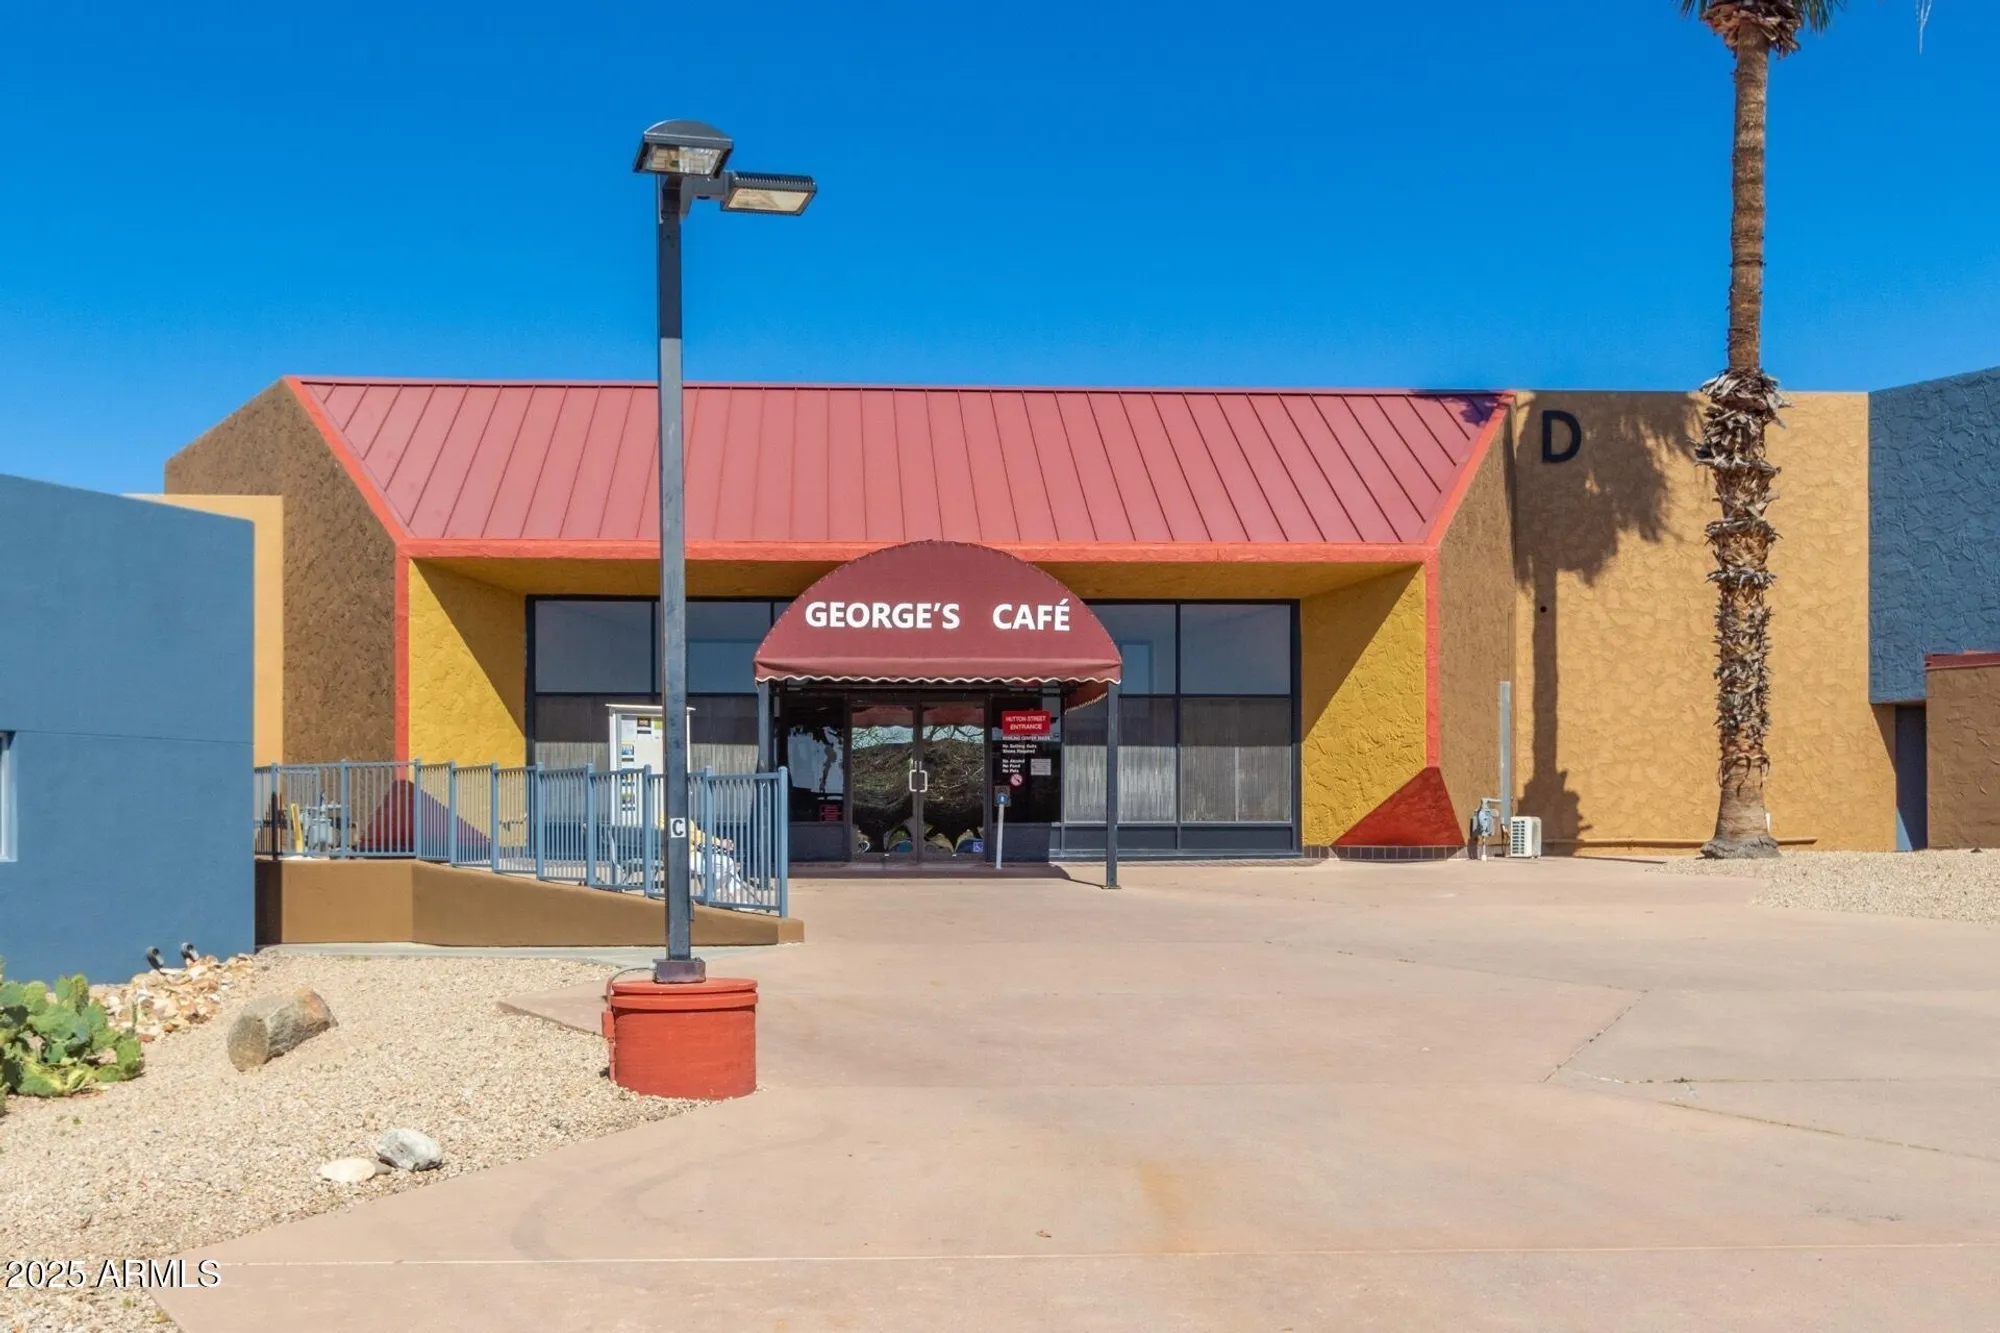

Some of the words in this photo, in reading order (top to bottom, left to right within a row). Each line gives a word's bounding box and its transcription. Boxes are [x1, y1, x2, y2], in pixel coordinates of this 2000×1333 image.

[1542, 410, 1582, 463] D
[805, 601, 960, 629] GEORGE'S
[992, 598, 1070, 631] CAFÉ
[671, 820, 684, 837] C
